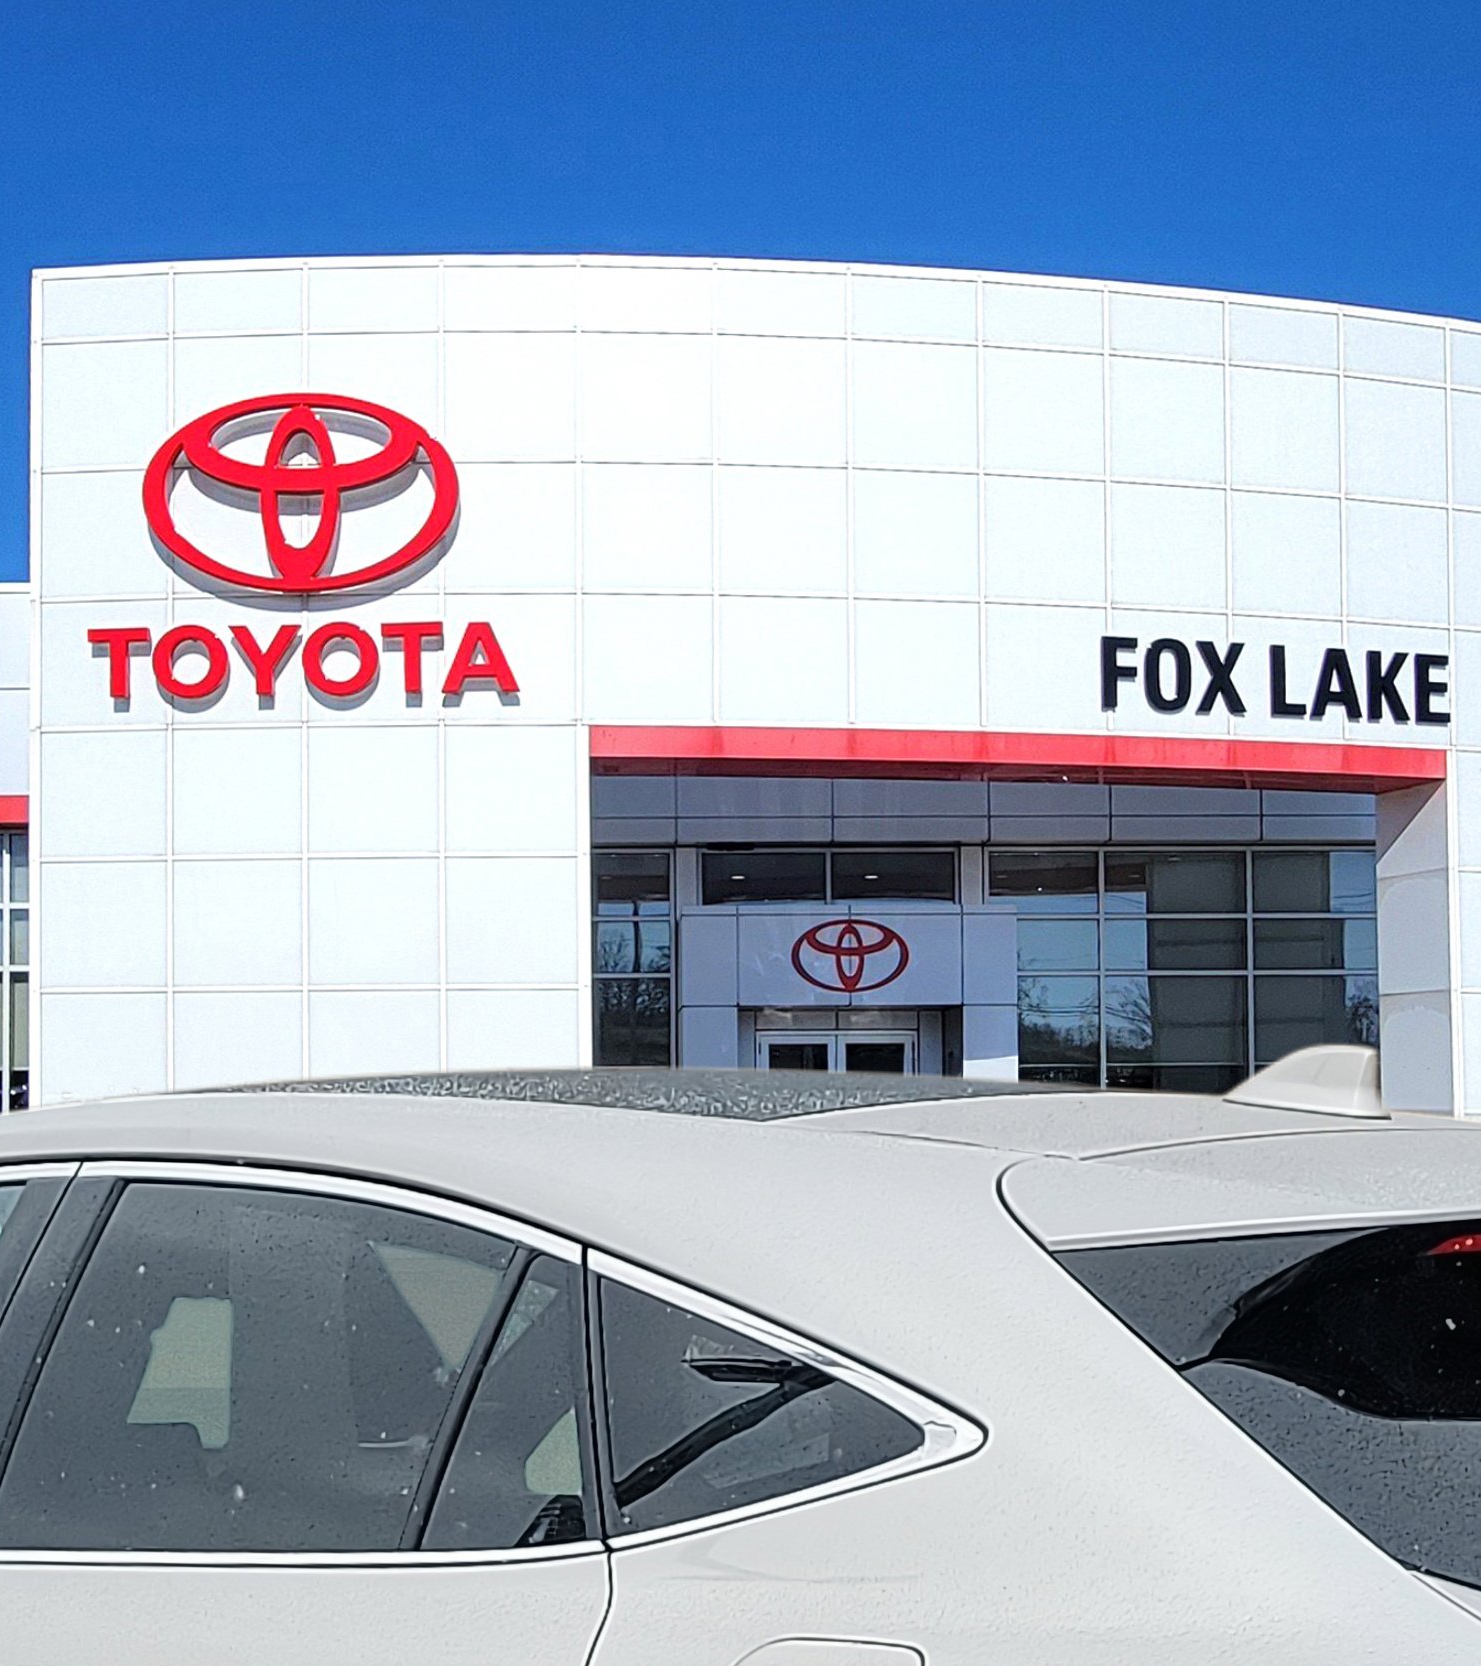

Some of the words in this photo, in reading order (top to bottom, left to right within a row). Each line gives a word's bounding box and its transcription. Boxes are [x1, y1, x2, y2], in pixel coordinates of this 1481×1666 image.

[87, 621, 520, 704] TOYOTA
[1100, 635, 1247, 716] FOX
[1269, 644, 1451, 724] LAKE
